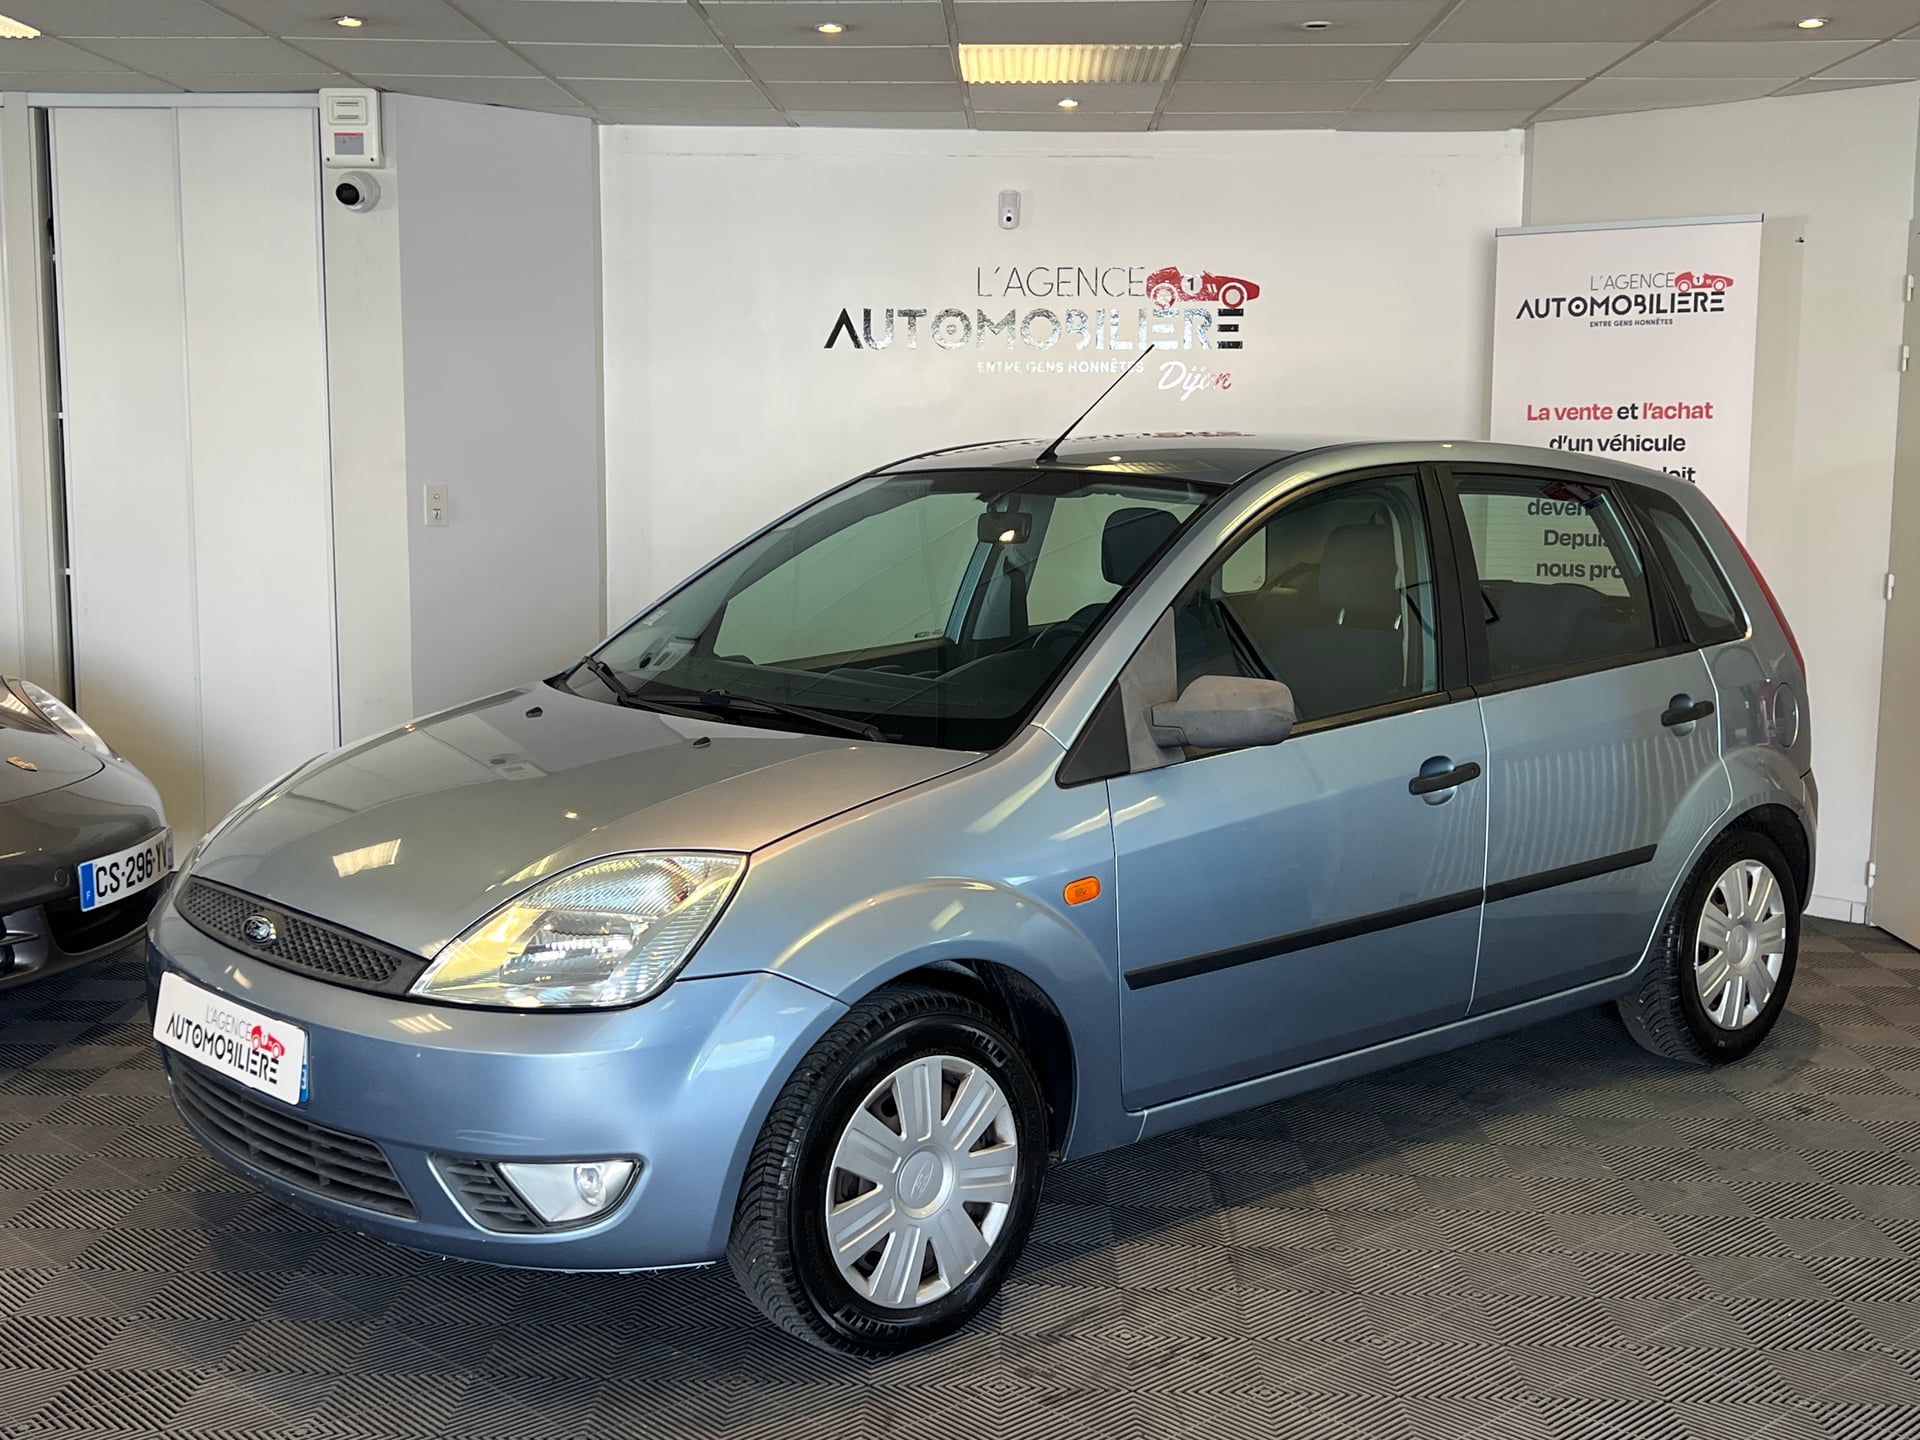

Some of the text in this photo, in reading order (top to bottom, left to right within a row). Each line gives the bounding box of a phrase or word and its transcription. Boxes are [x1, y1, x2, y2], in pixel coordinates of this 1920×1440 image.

[976, 266, 1146, 298] L'AGENCE
[1590, 272, 1676, 291] L'AGENCE
[1589, 320, 1612, 328] ENTRE
[1634, 318, 1674, 326] HONNÊTES
[976, 357, 1145, 374] ENTRE GENS HONNÊTES
[1157, 360, 1233, 401] Dijon
[1527, 402, 1714, 422] La vente et l'achat
[1549, 433, 1687, 453] d'un véhicule
[1543, 529, 1609, 550] Depui
[1536, 562, 1586, 578] nous
[204, 1004, 252, 1042] L'AGENCE
